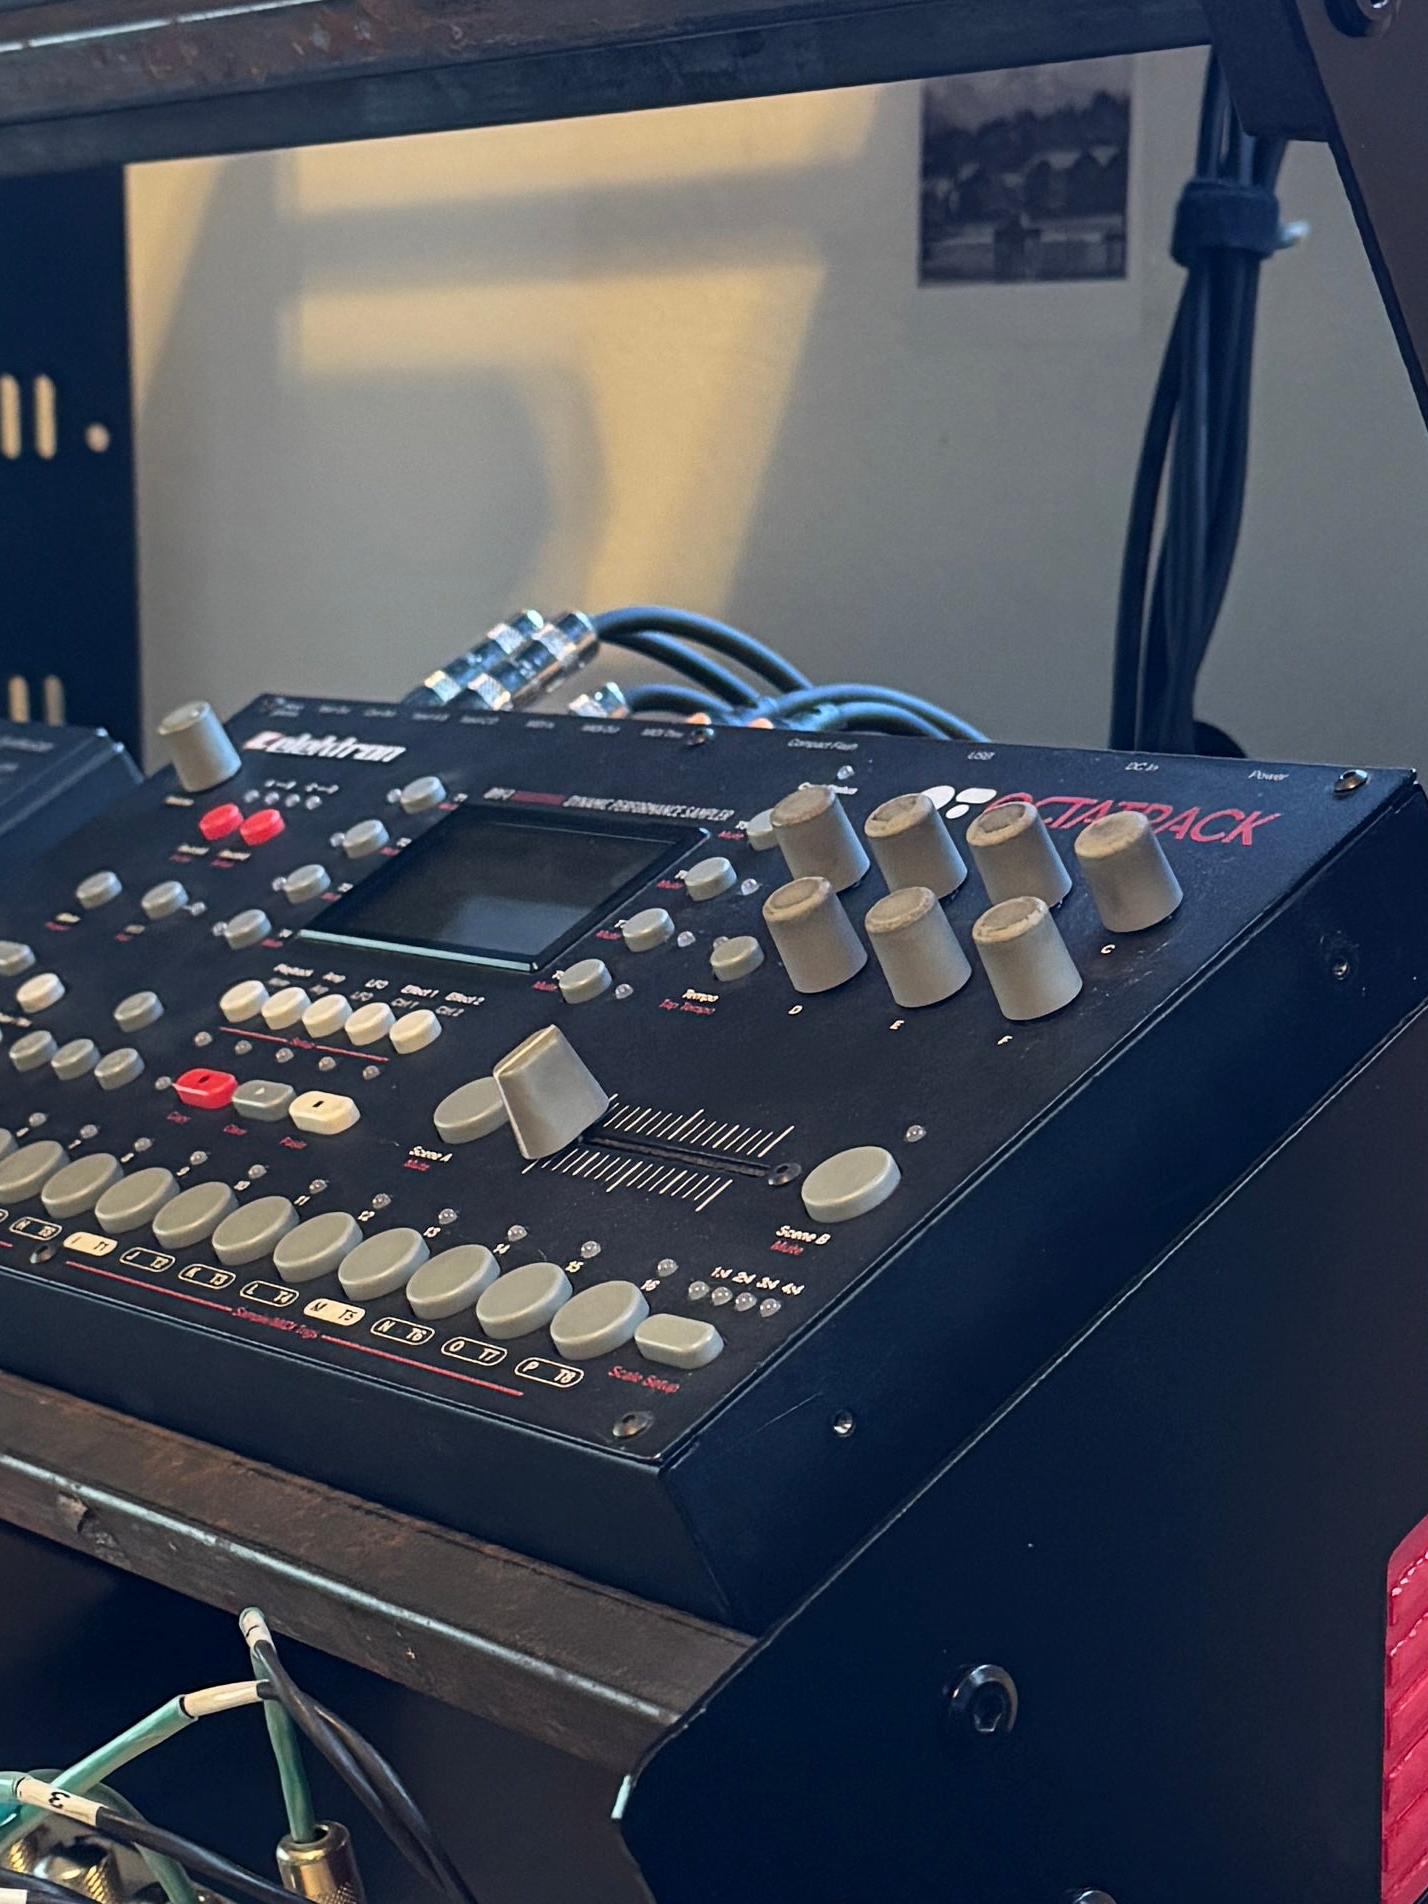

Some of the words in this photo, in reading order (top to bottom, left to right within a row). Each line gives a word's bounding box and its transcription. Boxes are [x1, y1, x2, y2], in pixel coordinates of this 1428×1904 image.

[1247, 769, 1290, 782] Power
[1100, 943, 1116, 955] C
[788, 1004, 803, 1015] D
[889, 1019, 905, 1030] E
[997, 1034, 1013, 1046] F
[409, 1145, 442, 1161] Scene
[439, 1152, 453, 1163] A
[293, 1195, 310, 1206] 11
[775, 1225, 816, 1242] Scene
[815, 1233, 831, 1245] B
[770, 1240, 804, 1256] Mute
[247, 1283, 259, 1295] L
[273, 1290, 294, 1304] T4
[337, 1309, 359, 1322] T5
[377, 1319, 395, 1333] N
[406, 1327, 427, 1342] T6
[449, 1340, 466, 1353] O
[477, 1347, 501, 1361] T7
[522, 1360, 540, 1373] P
[553, 1368, 577, 1384] T8
